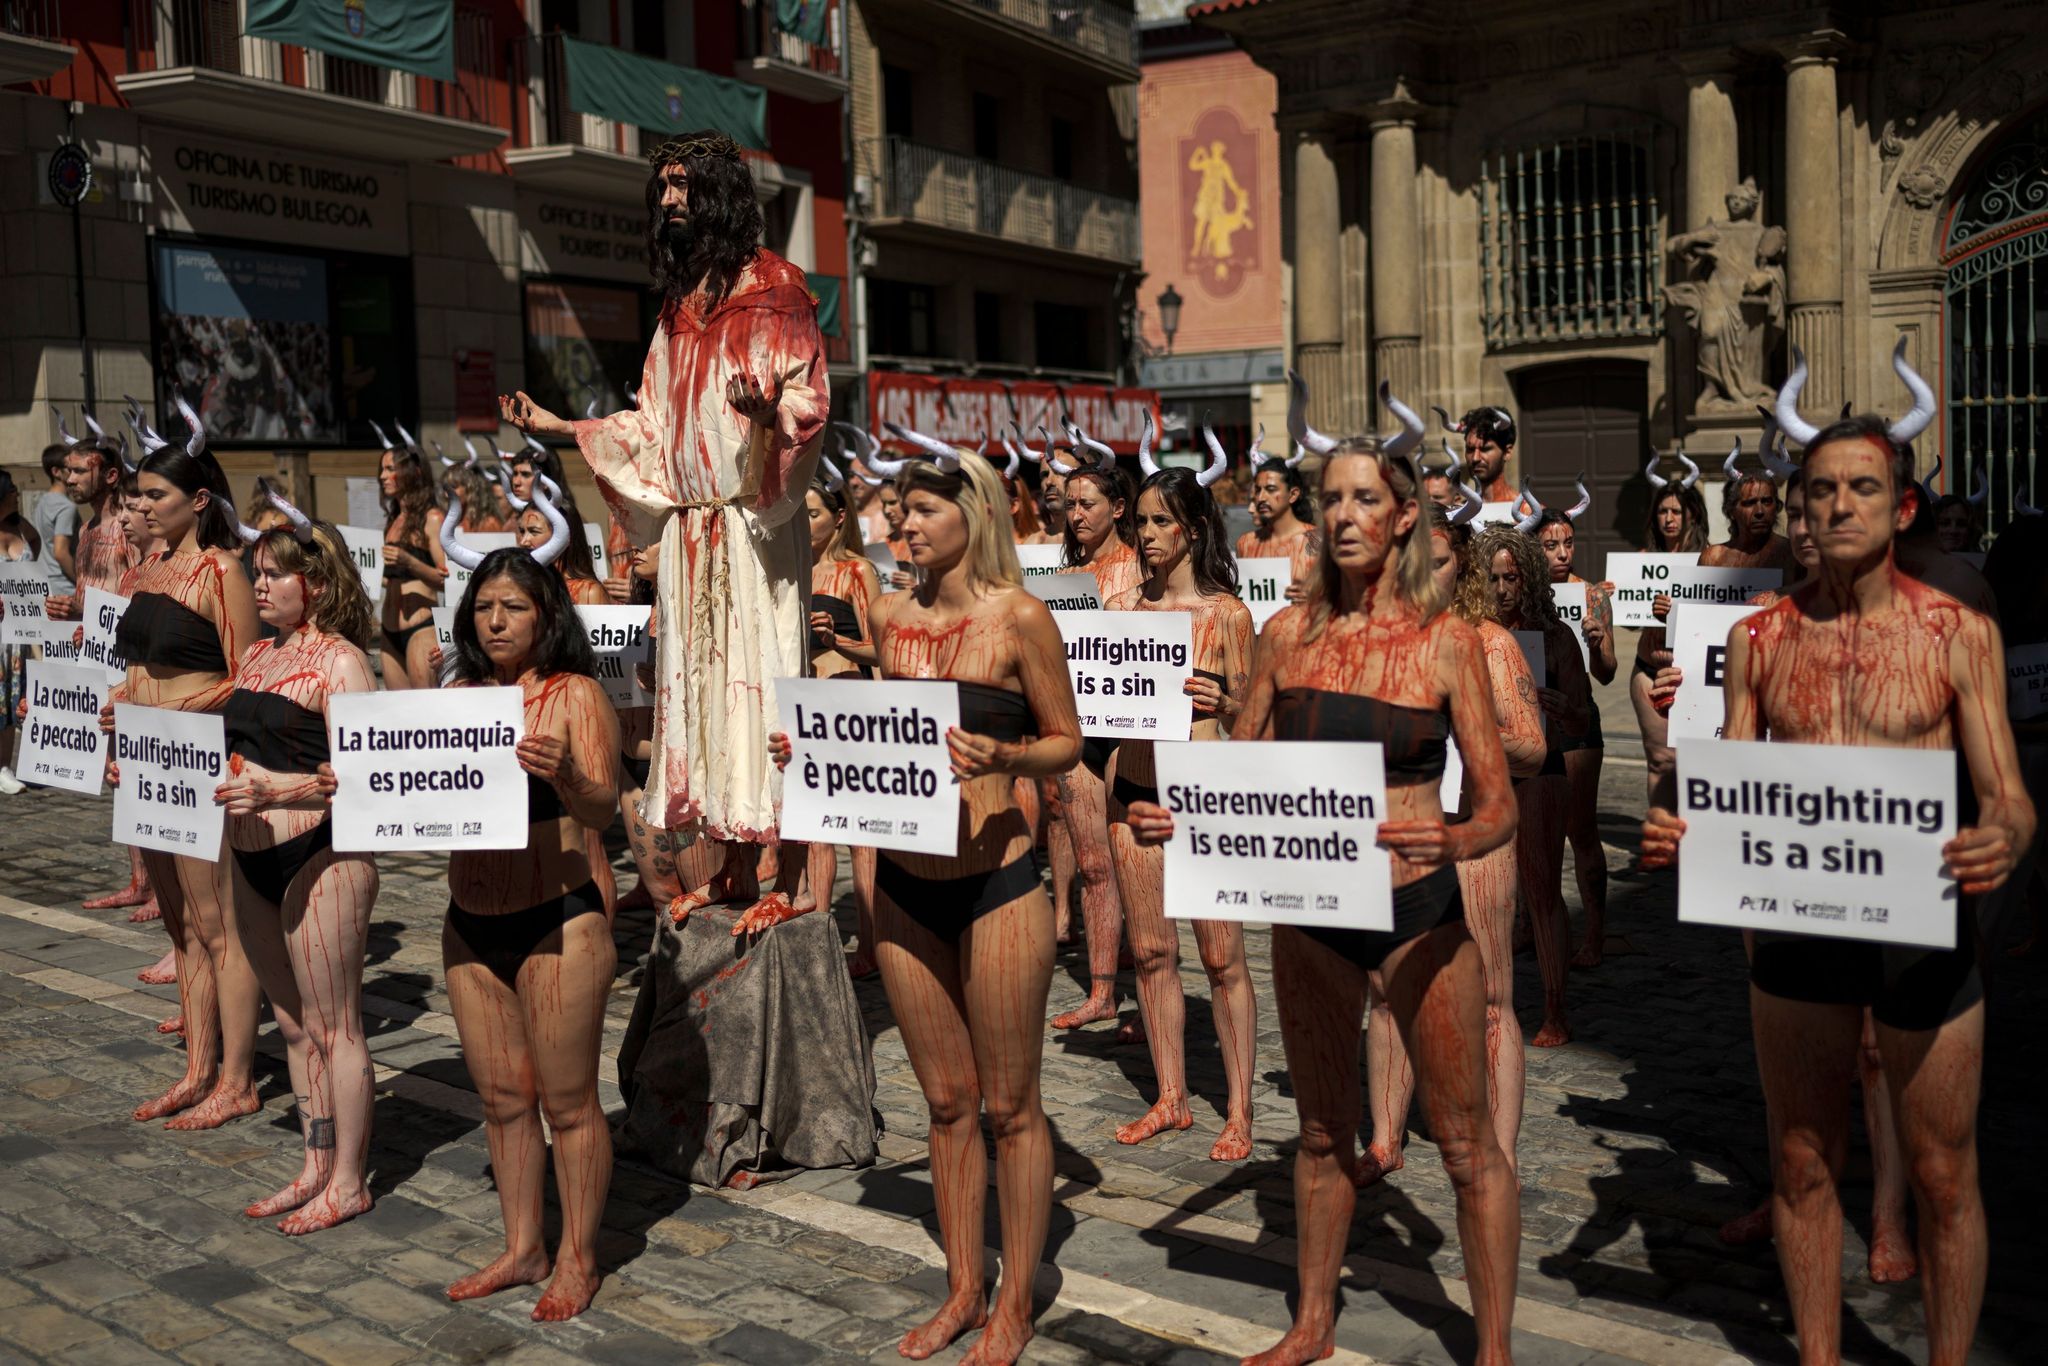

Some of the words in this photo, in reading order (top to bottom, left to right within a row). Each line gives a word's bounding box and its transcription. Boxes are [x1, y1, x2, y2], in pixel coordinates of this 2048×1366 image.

[175, 147, 263, 180] OFICINA
[269, 162, 295, 185] DE
[298, 166, 378, 198] TURISMO
[187, 183, 276, 216] TURISMO
[284, 198, 372, 228] BULEGOA
[1148, 364, 1208, 382] ACIA
[360, 547, 375, 568] hil
[1641, 565, 1669, 580] NO
[1044, 593, 1099, 611] maquia
[1249, 578, 1276, 601] hil
[1671, 583, 1762, 603] Bullfight
[10, 602, 20, 617] is
[20, 606, 27, 617] a
[29, 602, 42, 617] sin
[99, 604, 115, 635] Gij
[84, 636, 105, 664] niet
[439, 627, 451, 643] La
[590, 624, 643, 647] shalt
[1064, 636, 1187, 667] ullfighting
[1077, 671, 1095, 695] is
[1102, 677, 1115, 695] a
[1121, 672, 1155, 697] sin
[2010, 663, 2048, 678] ULLFI
[33, 680, 49, 708] La
[52, 685, 98, 716] corrida
[31, 716, 39, 744] è
[41, 724, 97, 754] peccato
[338, 726, 362, 752] La
[368, 721, 516, 753] tauromaquia
[795, 703, 828, 740] La
[834, 707, 939, 746] corrida
[118, 733, 221, 778] Bullfighting
[138, 773, 152, 801] is
[157, 782, 167, 803] a
[171, 780, 197, 808] sin
[369, 770, 394, 793] es
[400, 764, 484, 796] pecado
[804, 752, 819, 789] è
[826, 760, 937, 798] peccato
[1167, 784, 1375, 819] Stierenvechten
[1686, 777, 1944, 834] Bullfighting
[375, 823, 403, 837] PETA
[1189, 825, 1212, 855] is
[1217, 832, 1266, 858] een
[1272, 831, 1359, 862] zonde
[1741, 831, 1774, 867] is
[1786, 842, 1809, 870] a
[1821, 838, 1885, 876] sin
